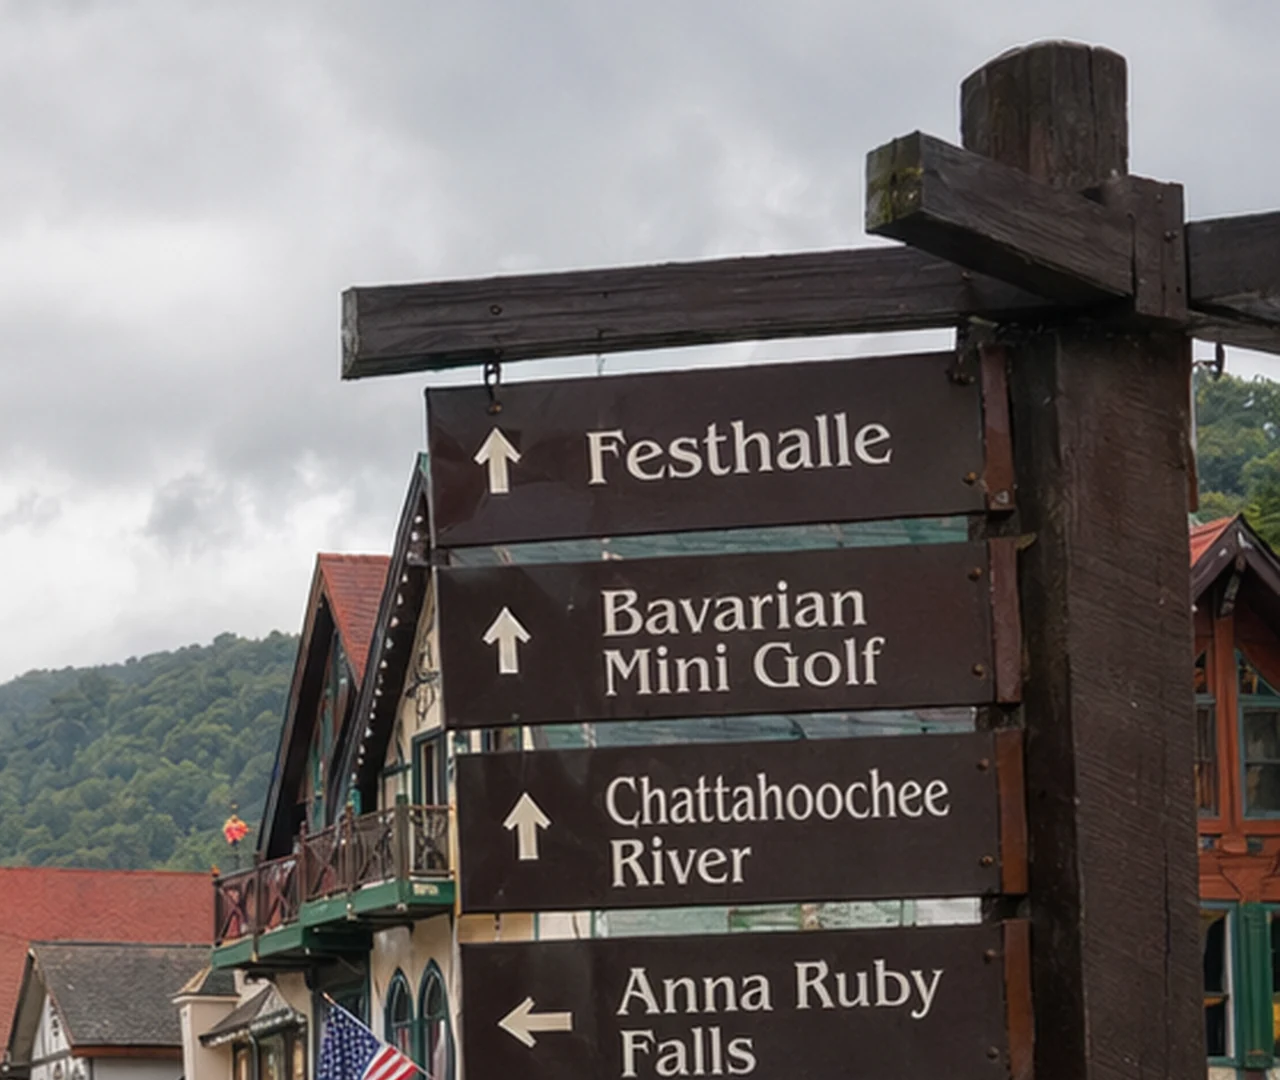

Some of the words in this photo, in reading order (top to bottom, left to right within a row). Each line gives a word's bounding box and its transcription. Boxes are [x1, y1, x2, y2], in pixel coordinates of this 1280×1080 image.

[586, 412, 892, 485] Festhalle
[601, 580, 868, 637] Bavarian
[604, 643, 730, 696] Mini
[751, 636, 886, 688] Golf
[606, 768, 950, 828] Chattahoochee
[611, 835, 752, 887] River
[616, 967, 773, 1016] Anna
[794, 959, 943, 1019] Ruby
[620, 1026, 756, 1078] Falls
